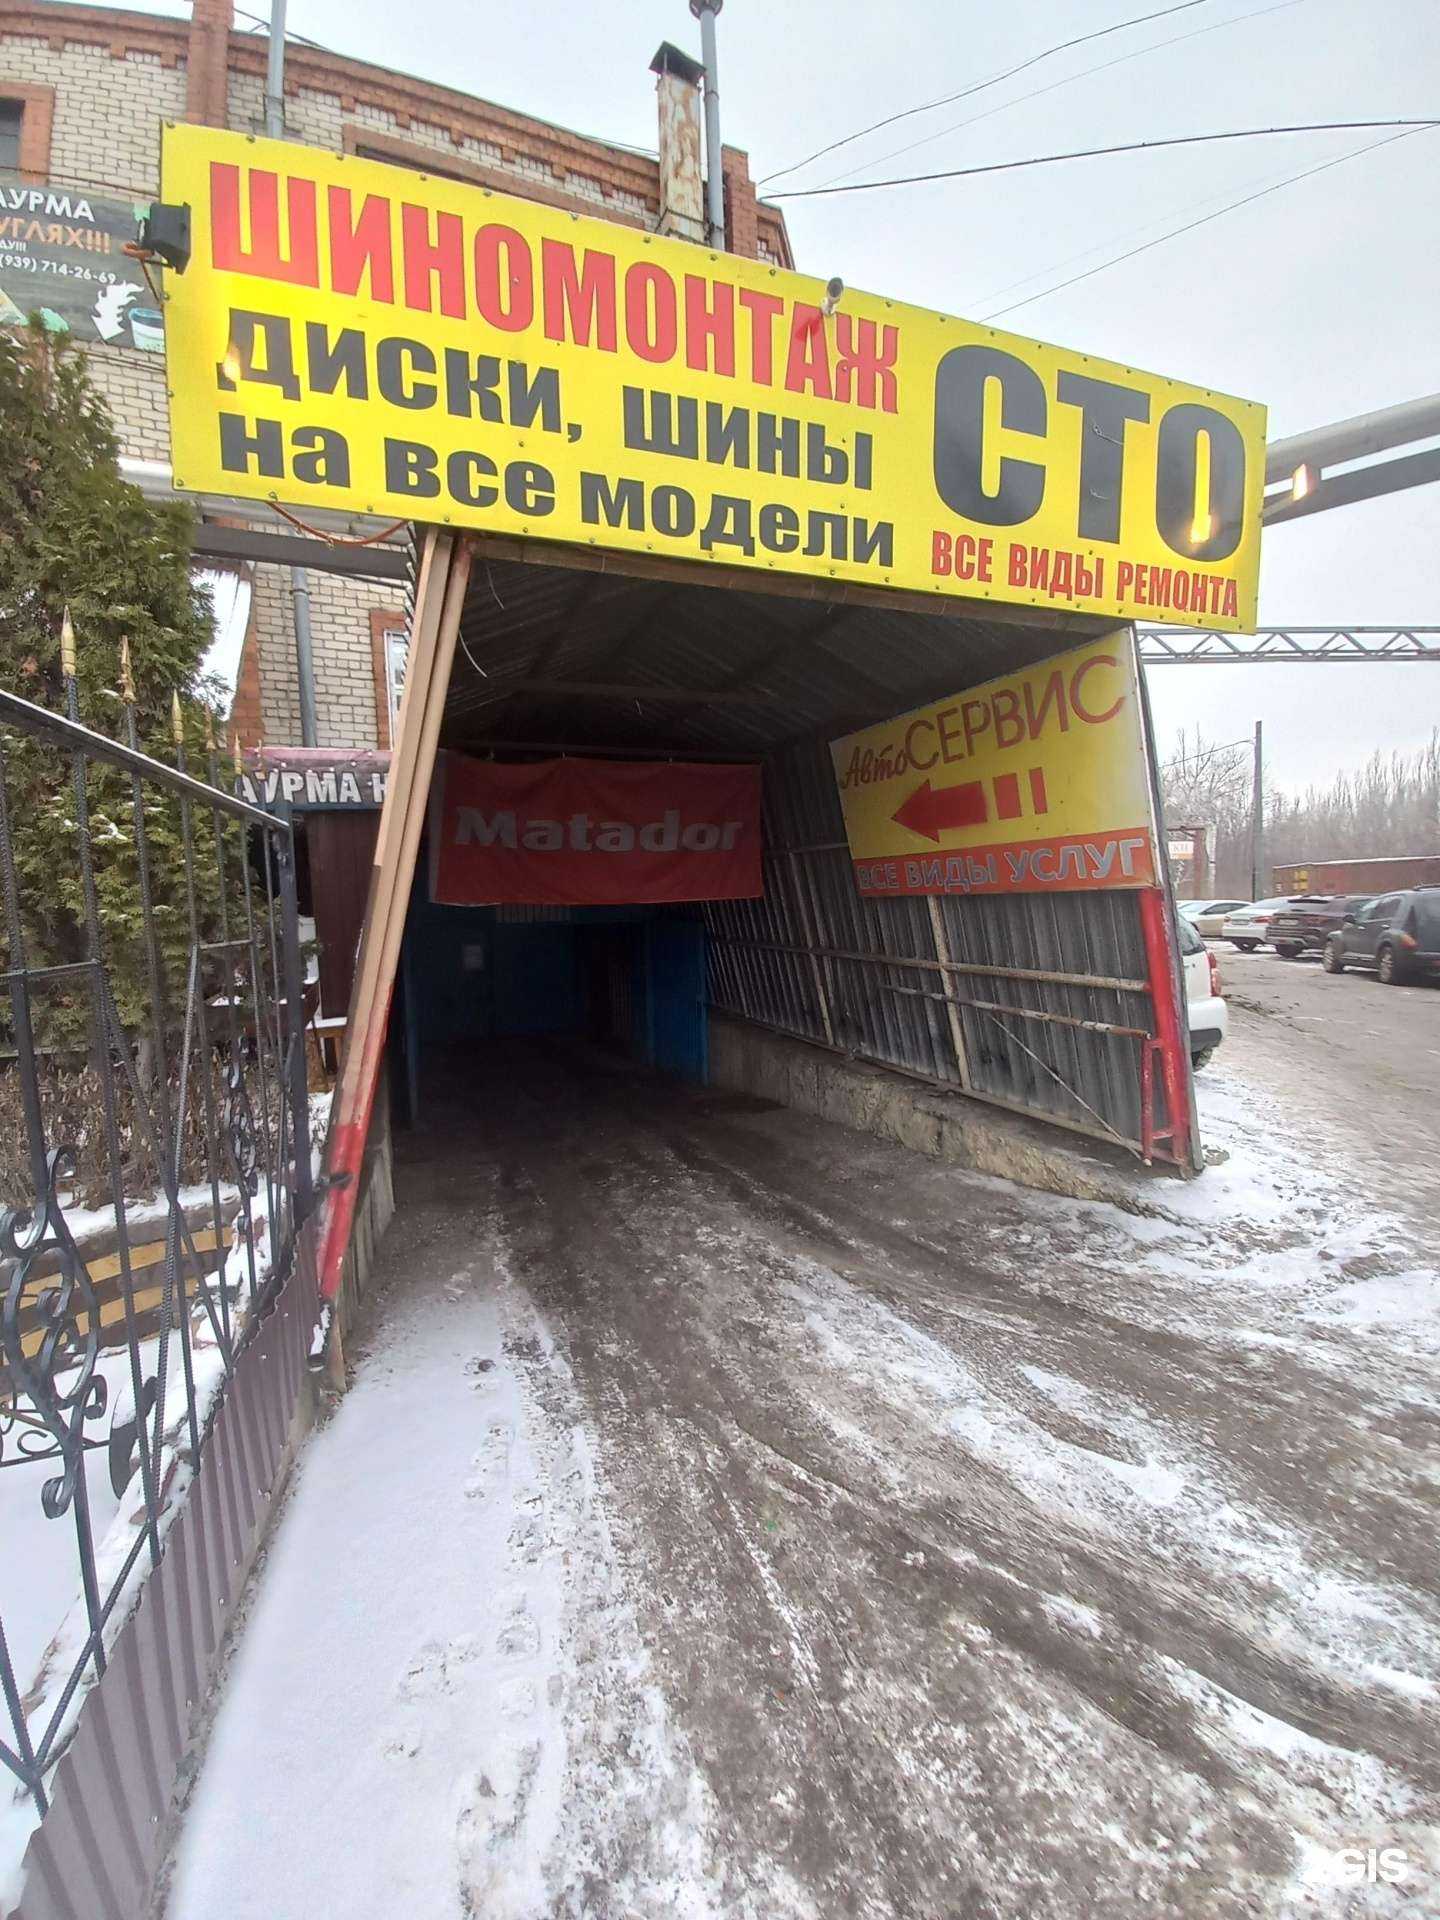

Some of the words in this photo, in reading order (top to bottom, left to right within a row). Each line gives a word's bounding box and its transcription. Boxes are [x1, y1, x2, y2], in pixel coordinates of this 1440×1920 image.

[42, 260, 116, 284] 714-26-69
[210, 161, 898, 414] ШИНОМОНТАЖ
[219, 413, 350, 488] на
[384, 438, 555, 516] все
[580, 471, 894, 567] модели
[933, 344, 1246, 562] СТО
[932, 530, 993, 582] ВСЕ
[1008, 543, 1104, 601] ВИДЫ
[1116, 561, 1239, 617] РЕМОНТА
[455, 806, 743, 851] Matador
[856, 863, 899, 890] ВСЕ
[905, 854, 998, 893] ВИДЫ
[1005, 838, 1145, 883] УСЛУГ
